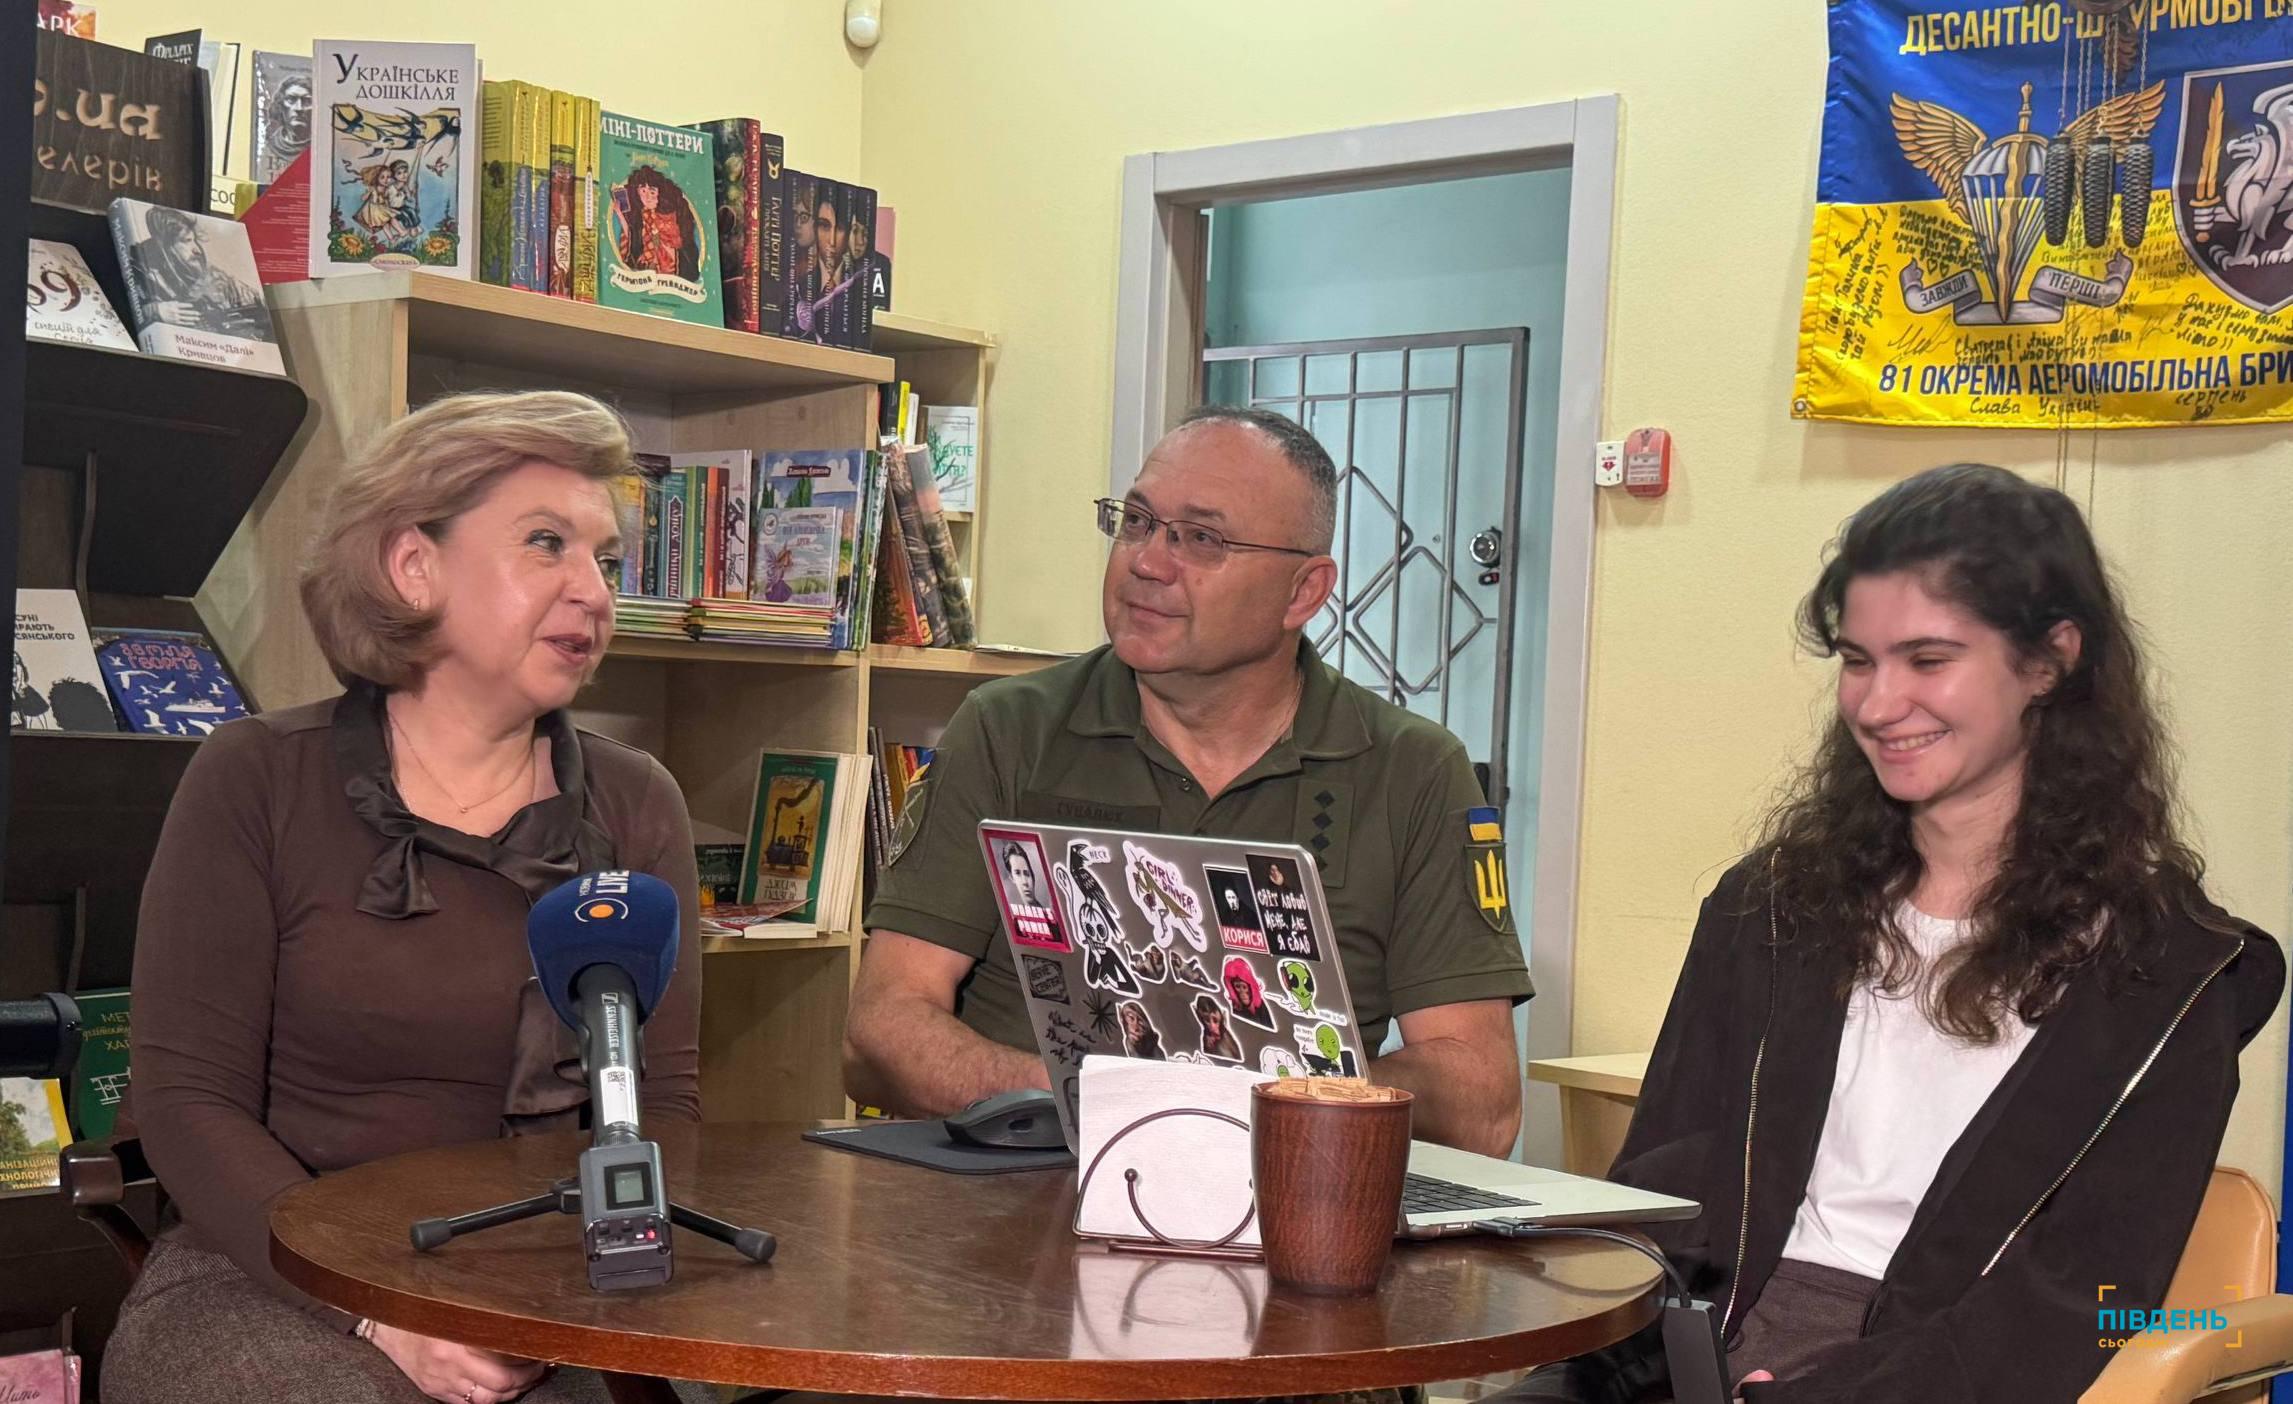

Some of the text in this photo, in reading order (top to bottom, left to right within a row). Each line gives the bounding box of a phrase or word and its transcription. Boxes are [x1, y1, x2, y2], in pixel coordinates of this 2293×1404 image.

[332, 53, 459, 84] УКРАЇНСЬКЕ
[356, 84, 456, 101] ДОШКІЛЛЯ
[1920, 275, 1969, 307] ЗАВЖДИ
[2050, 272, 2101, 299] ПЕРШІ
[1879, 363, 1912, 394] 81
[1920, 362, 2022, 395] ОКРЕМА
[2028, 355, 2231, 395] АЕРОМОБІЛЬНА
[1969, 396, 2021, 414] Слава
[1146, 861, 1174, 886] GIRL
[1161, 880, 1194, 908] DINNER
[1223, 928, 1265, 947] КОРИСЯ
[605, 1005, 620, 1048] SENNHEISER
